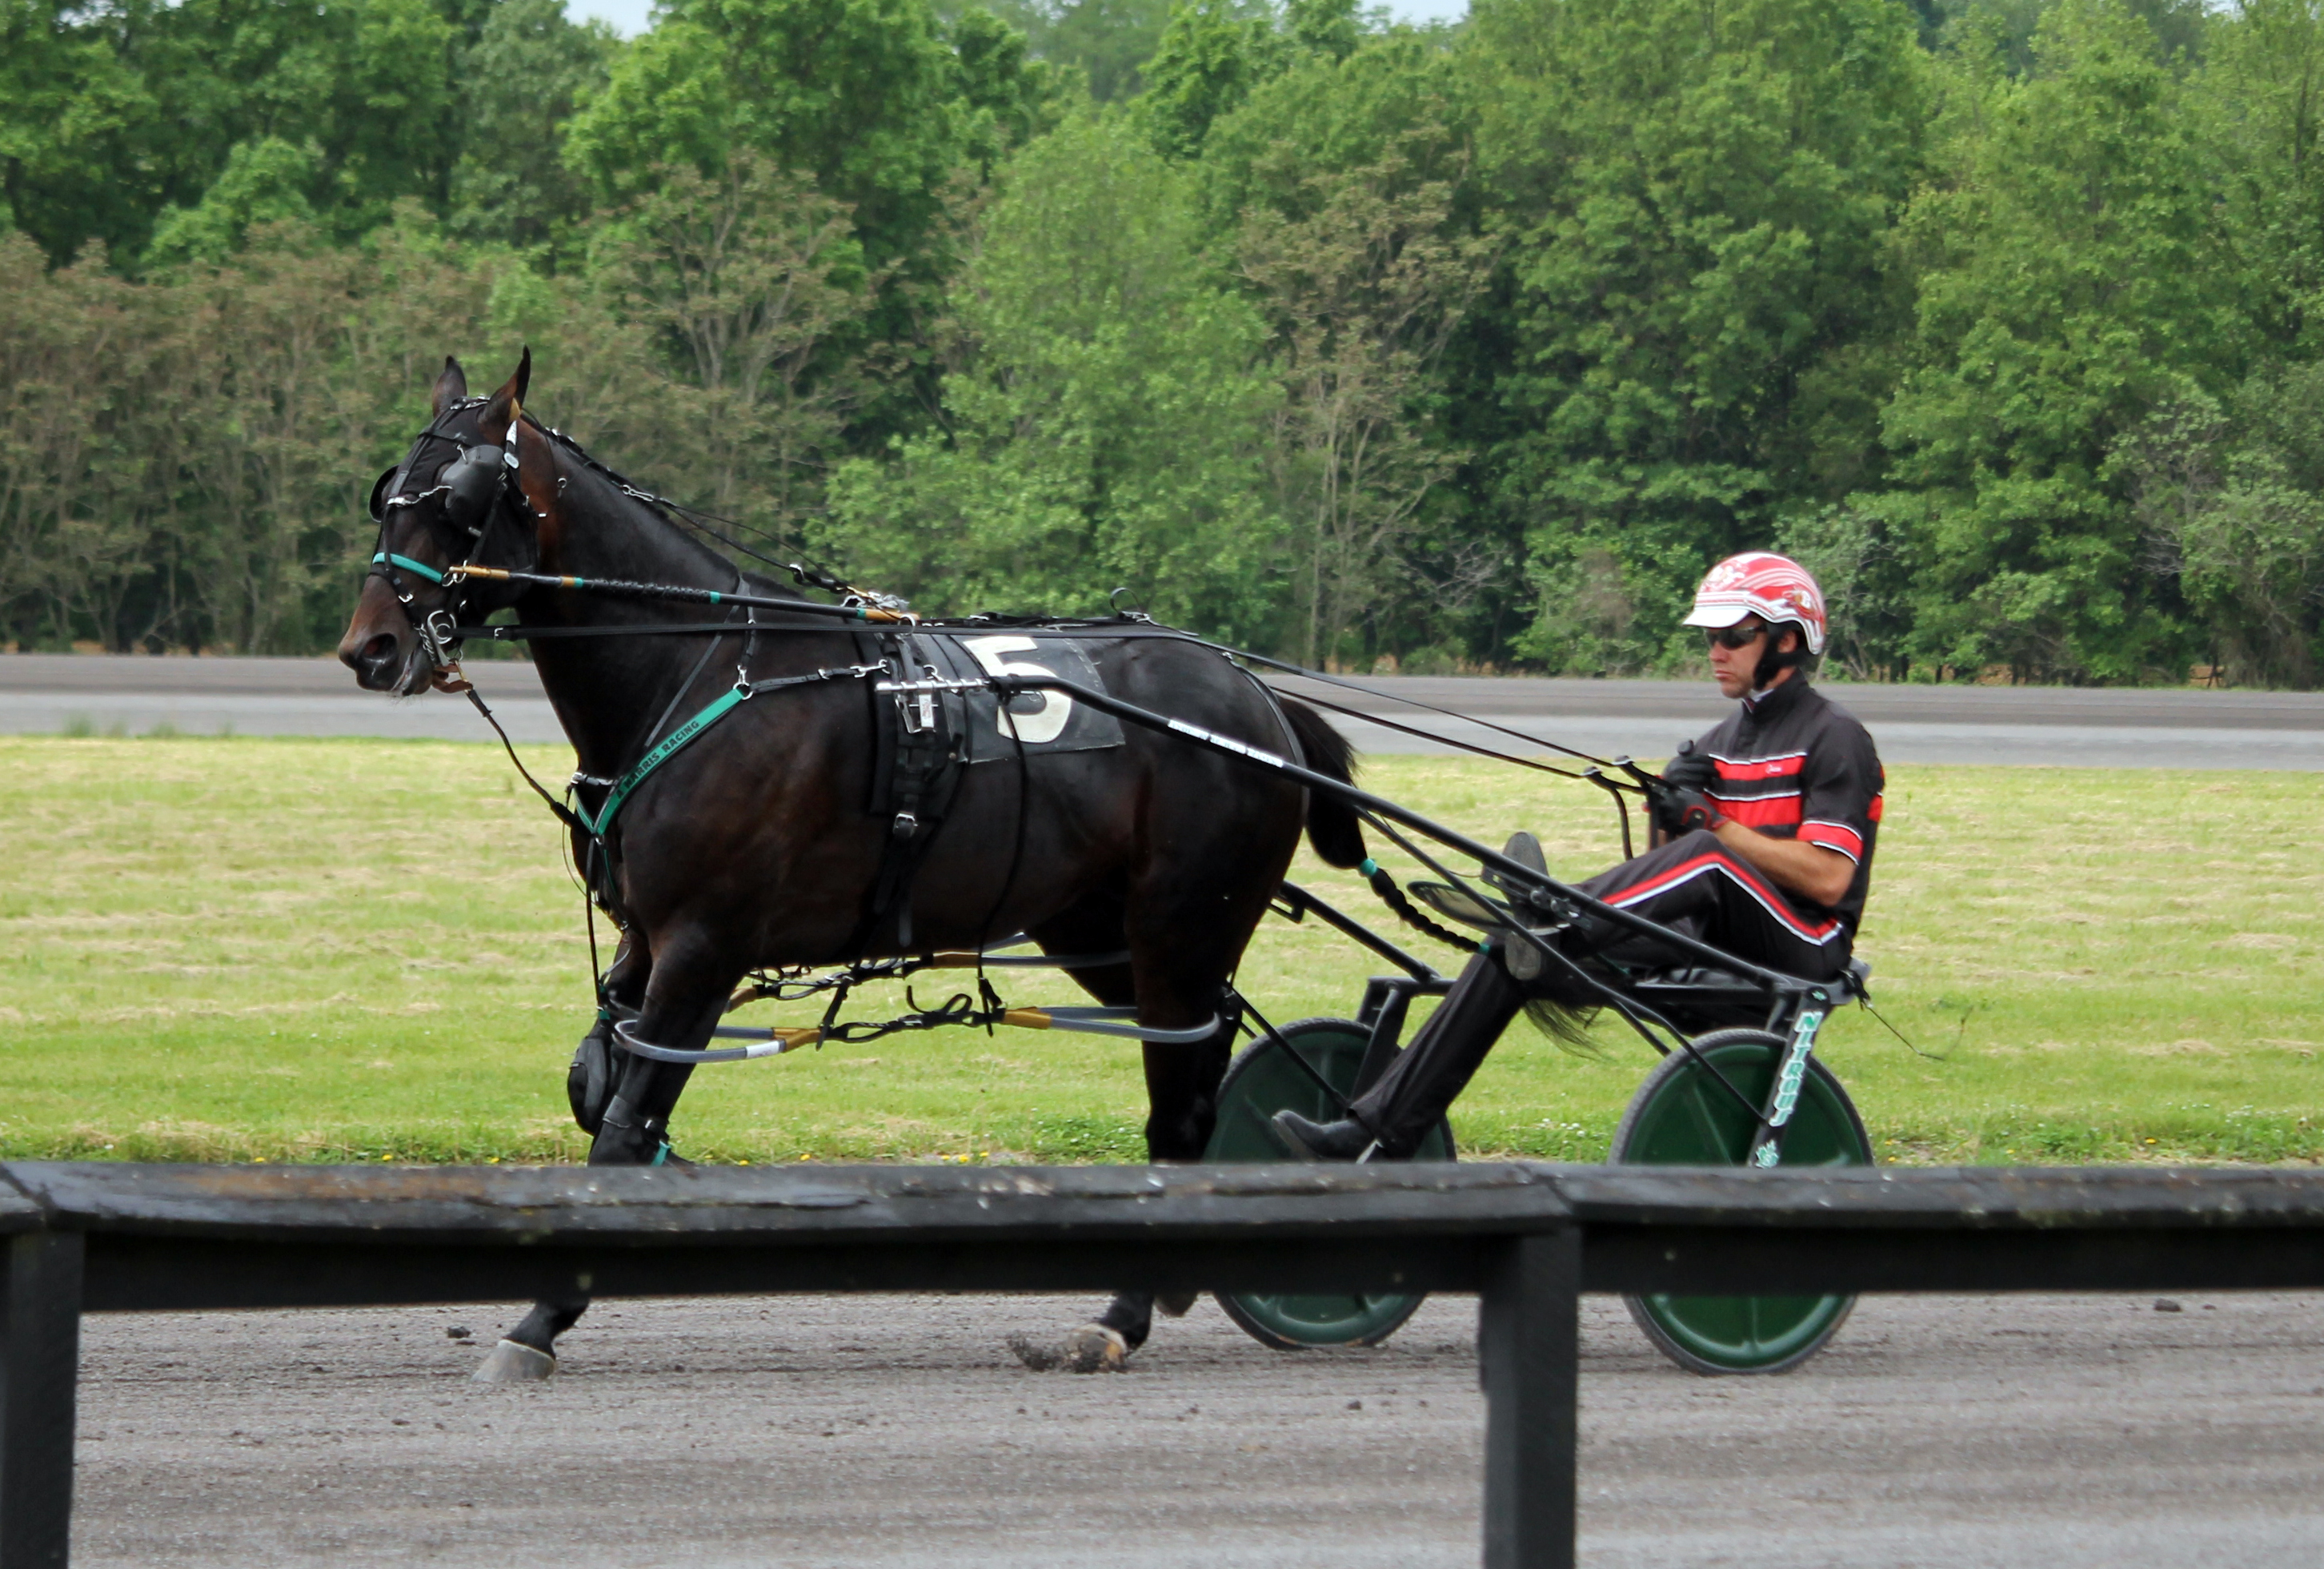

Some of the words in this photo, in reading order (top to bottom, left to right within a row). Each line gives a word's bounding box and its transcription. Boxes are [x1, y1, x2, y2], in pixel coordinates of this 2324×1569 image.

[963, 636, 1072, 744] 5
[624, 752, 661, 789] HARRIS
[661, 720, 700, 753] RACING
